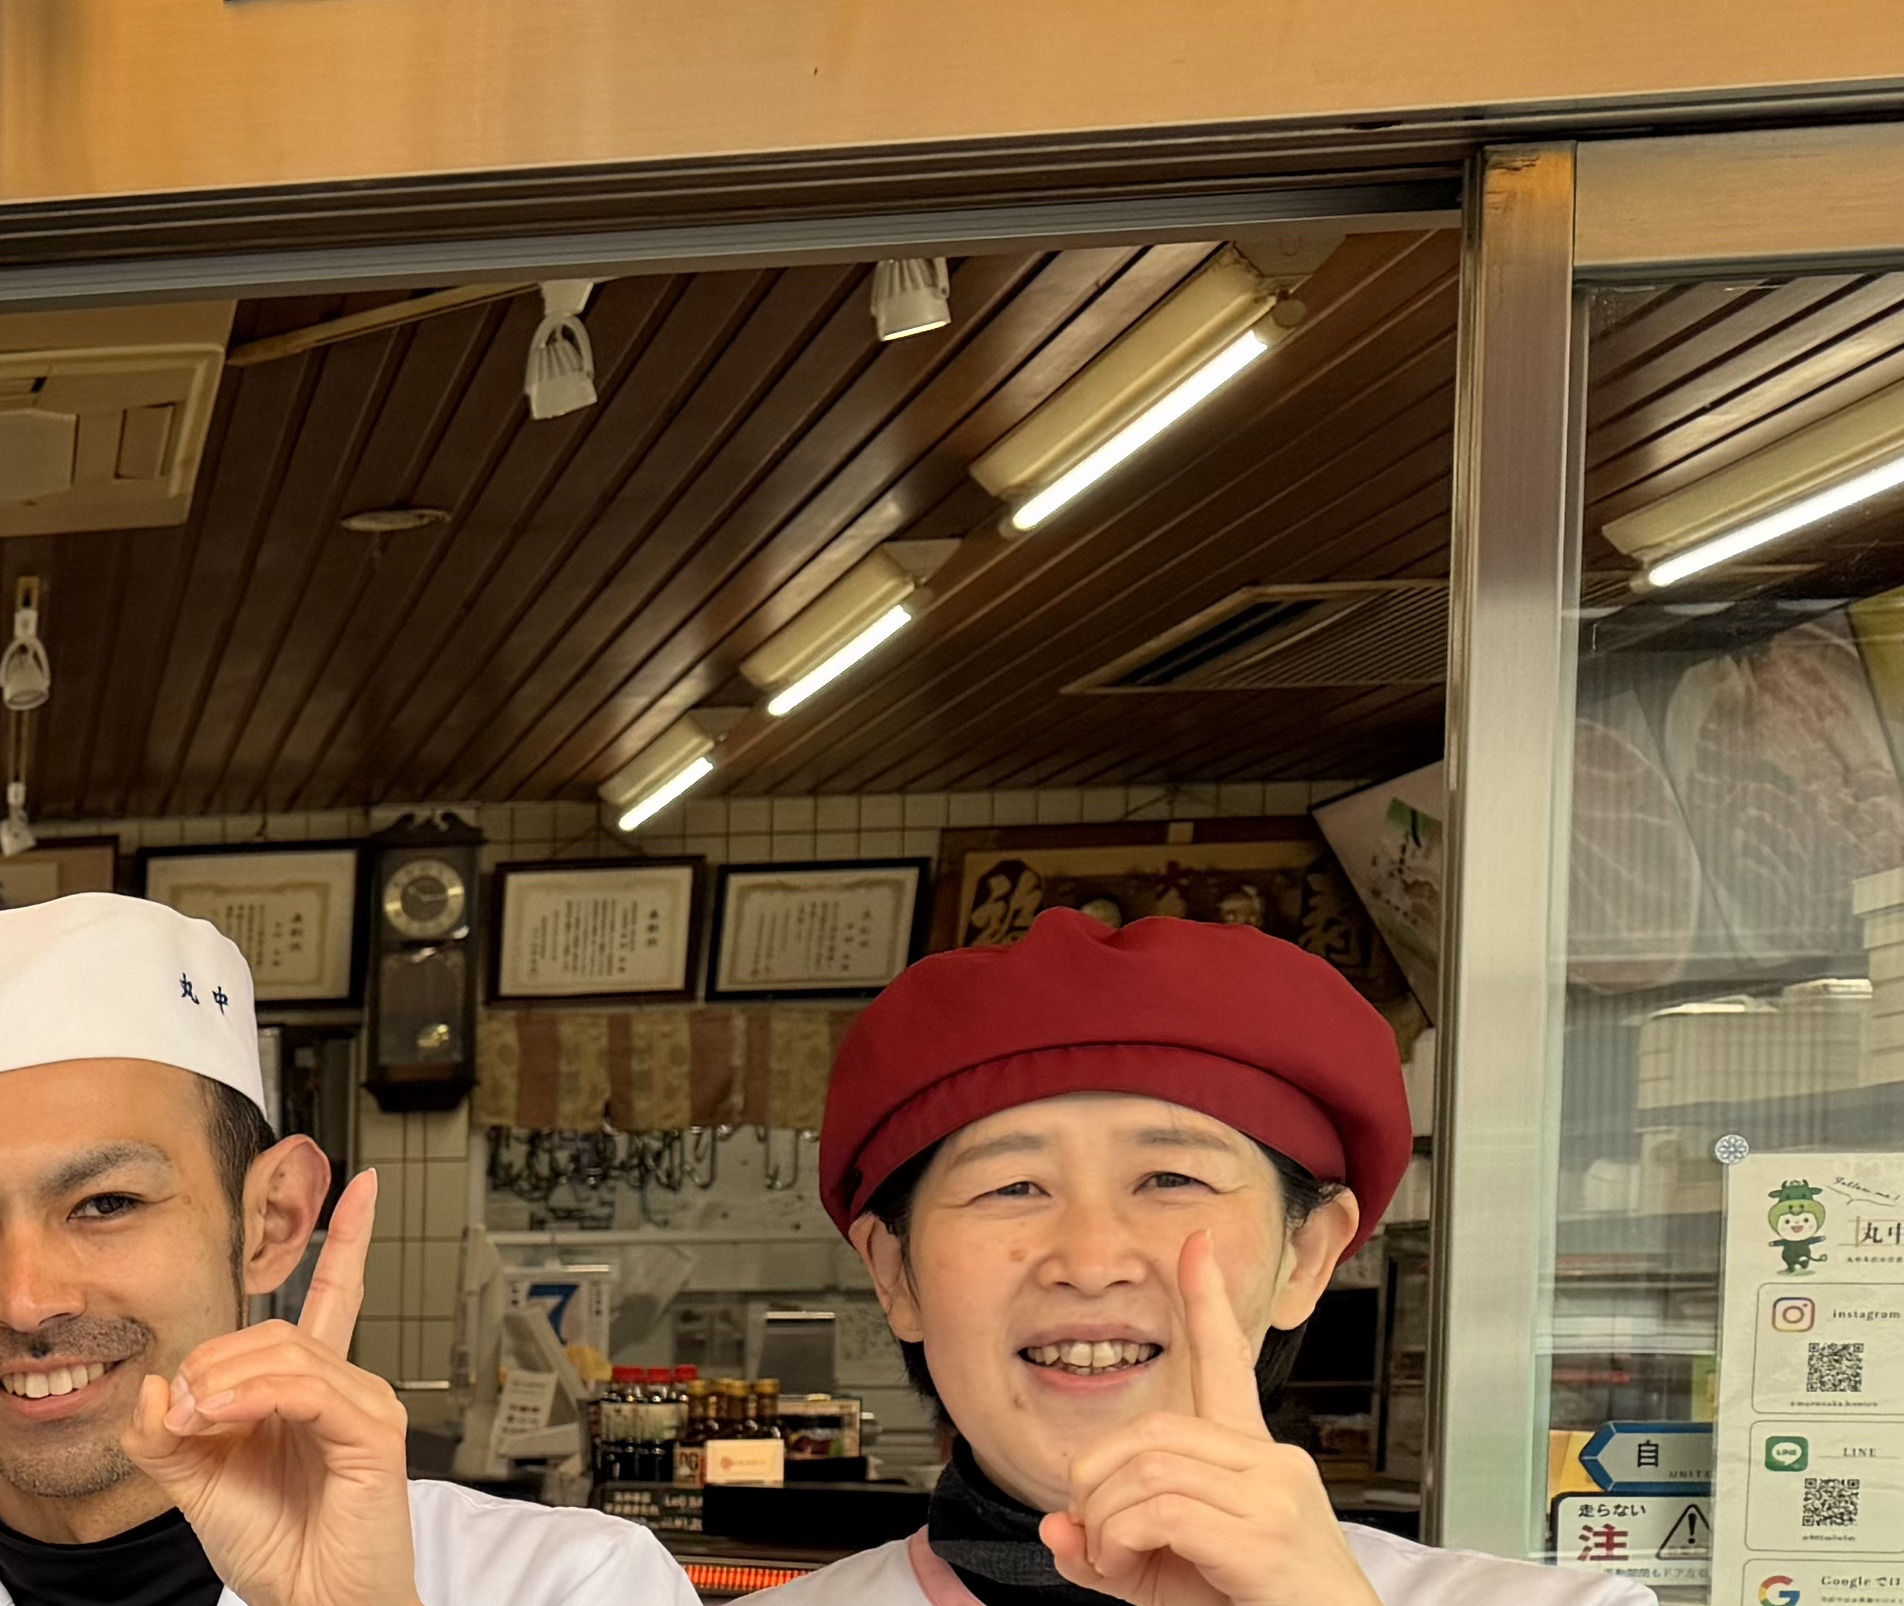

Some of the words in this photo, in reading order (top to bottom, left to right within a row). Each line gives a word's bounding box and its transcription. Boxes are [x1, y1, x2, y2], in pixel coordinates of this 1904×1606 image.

[178, 972, 229, 1016] 丸中
[1637, 1439, 1659, 1467] 自
[1842, 1447, 1877, 1458] LINE
[1578, 1503, 1646, 1518] 走らない
[1577, 1523, 1629, 1562] 注
[1820, 1575, 1872, 1588] Google
